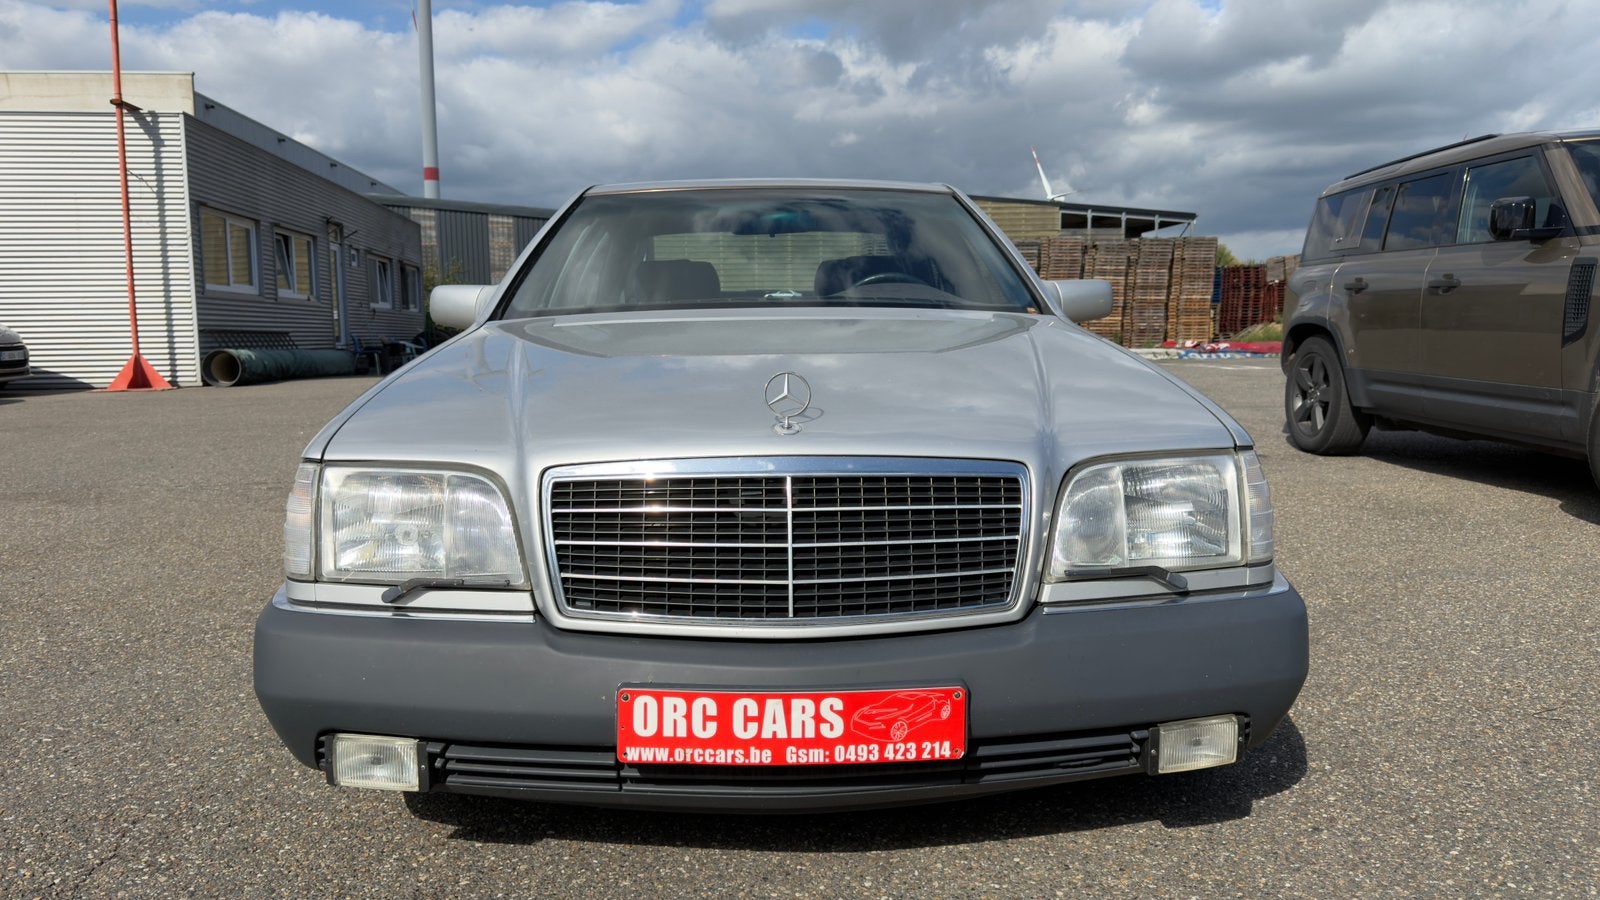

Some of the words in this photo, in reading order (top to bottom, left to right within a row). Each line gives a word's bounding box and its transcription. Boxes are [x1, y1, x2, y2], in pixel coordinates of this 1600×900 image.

[633, 694, 718, 740] ORC
[732, 696, 844, 740] CARS
[626, 746, 772, 764] www.orccars.be
[786, 746, 830, 763] Gsm:
[834, 744, 880, 763] 0493
[884, 743, 917, 761] 423
[922, 741, 951, 759] 214
